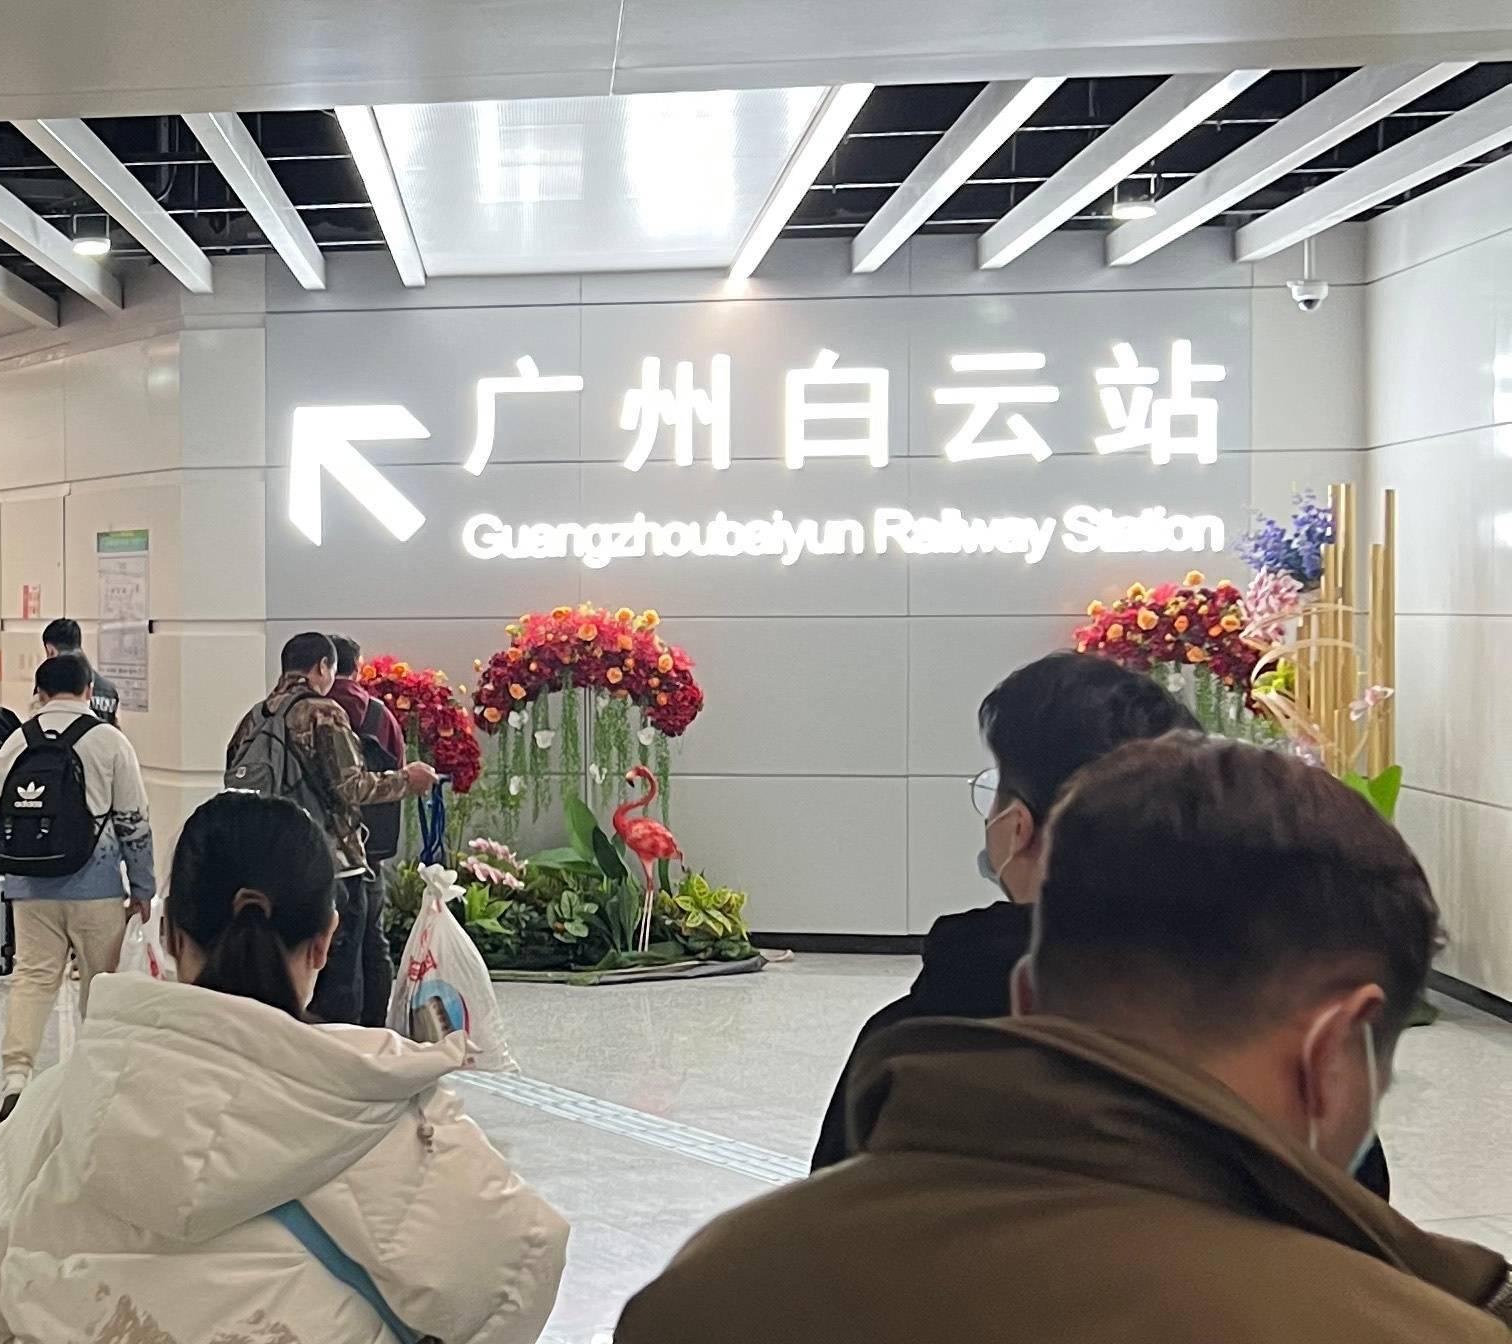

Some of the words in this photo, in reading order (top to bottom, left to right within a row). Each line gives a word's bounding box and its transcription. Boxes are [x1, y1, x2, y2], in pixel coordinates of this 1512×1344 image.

[463, 339, 1226, 476] 广州白云站
[462, 510, 864, 568] Guangzhoubaiyun
[873, 507, 1057, 564] Railway
[1062, 505, 1225, 553] Station
